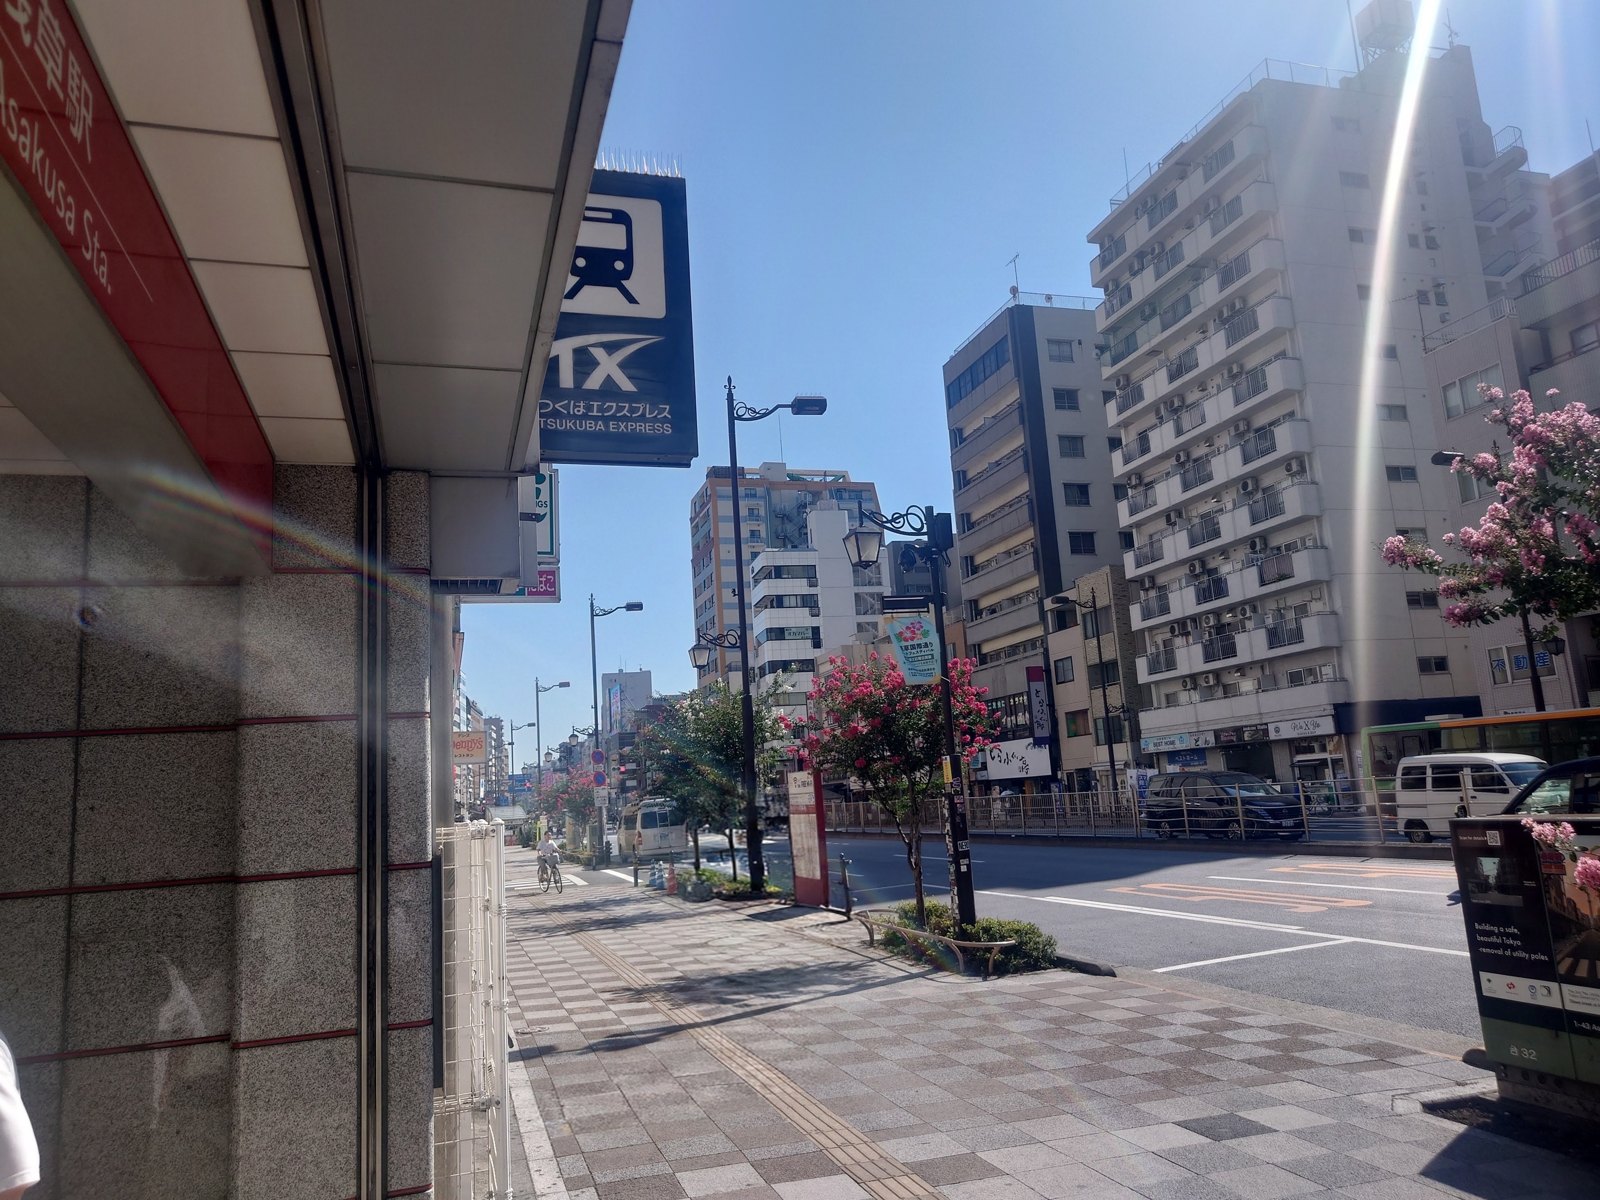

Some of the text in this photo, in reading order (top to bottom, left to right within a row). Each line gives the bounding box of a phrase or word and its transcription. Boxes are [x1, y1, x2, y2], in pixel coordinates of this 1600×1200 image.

[82, 209, 112, 295] Sta.
[538, 400, 671, 419] つくばエクスプレス
[539, 418, 672, 434] TSUKUBA EXPRESS
[536, 500, 548, 508] GS
[1492, 650, 1551, 672] 不動産
[1474, 922, 1498, 933] Building
[1505, 925, 1520, 934] safe,
[1476, 934, 1521, 946] beautiful Tokyo
[1504, 948, 1511, 956] of
[1512, 950, 1529, 960] utility
[1530, 952, 1549, 961] poles
[1520, 1047, 1537, 1060] 32
